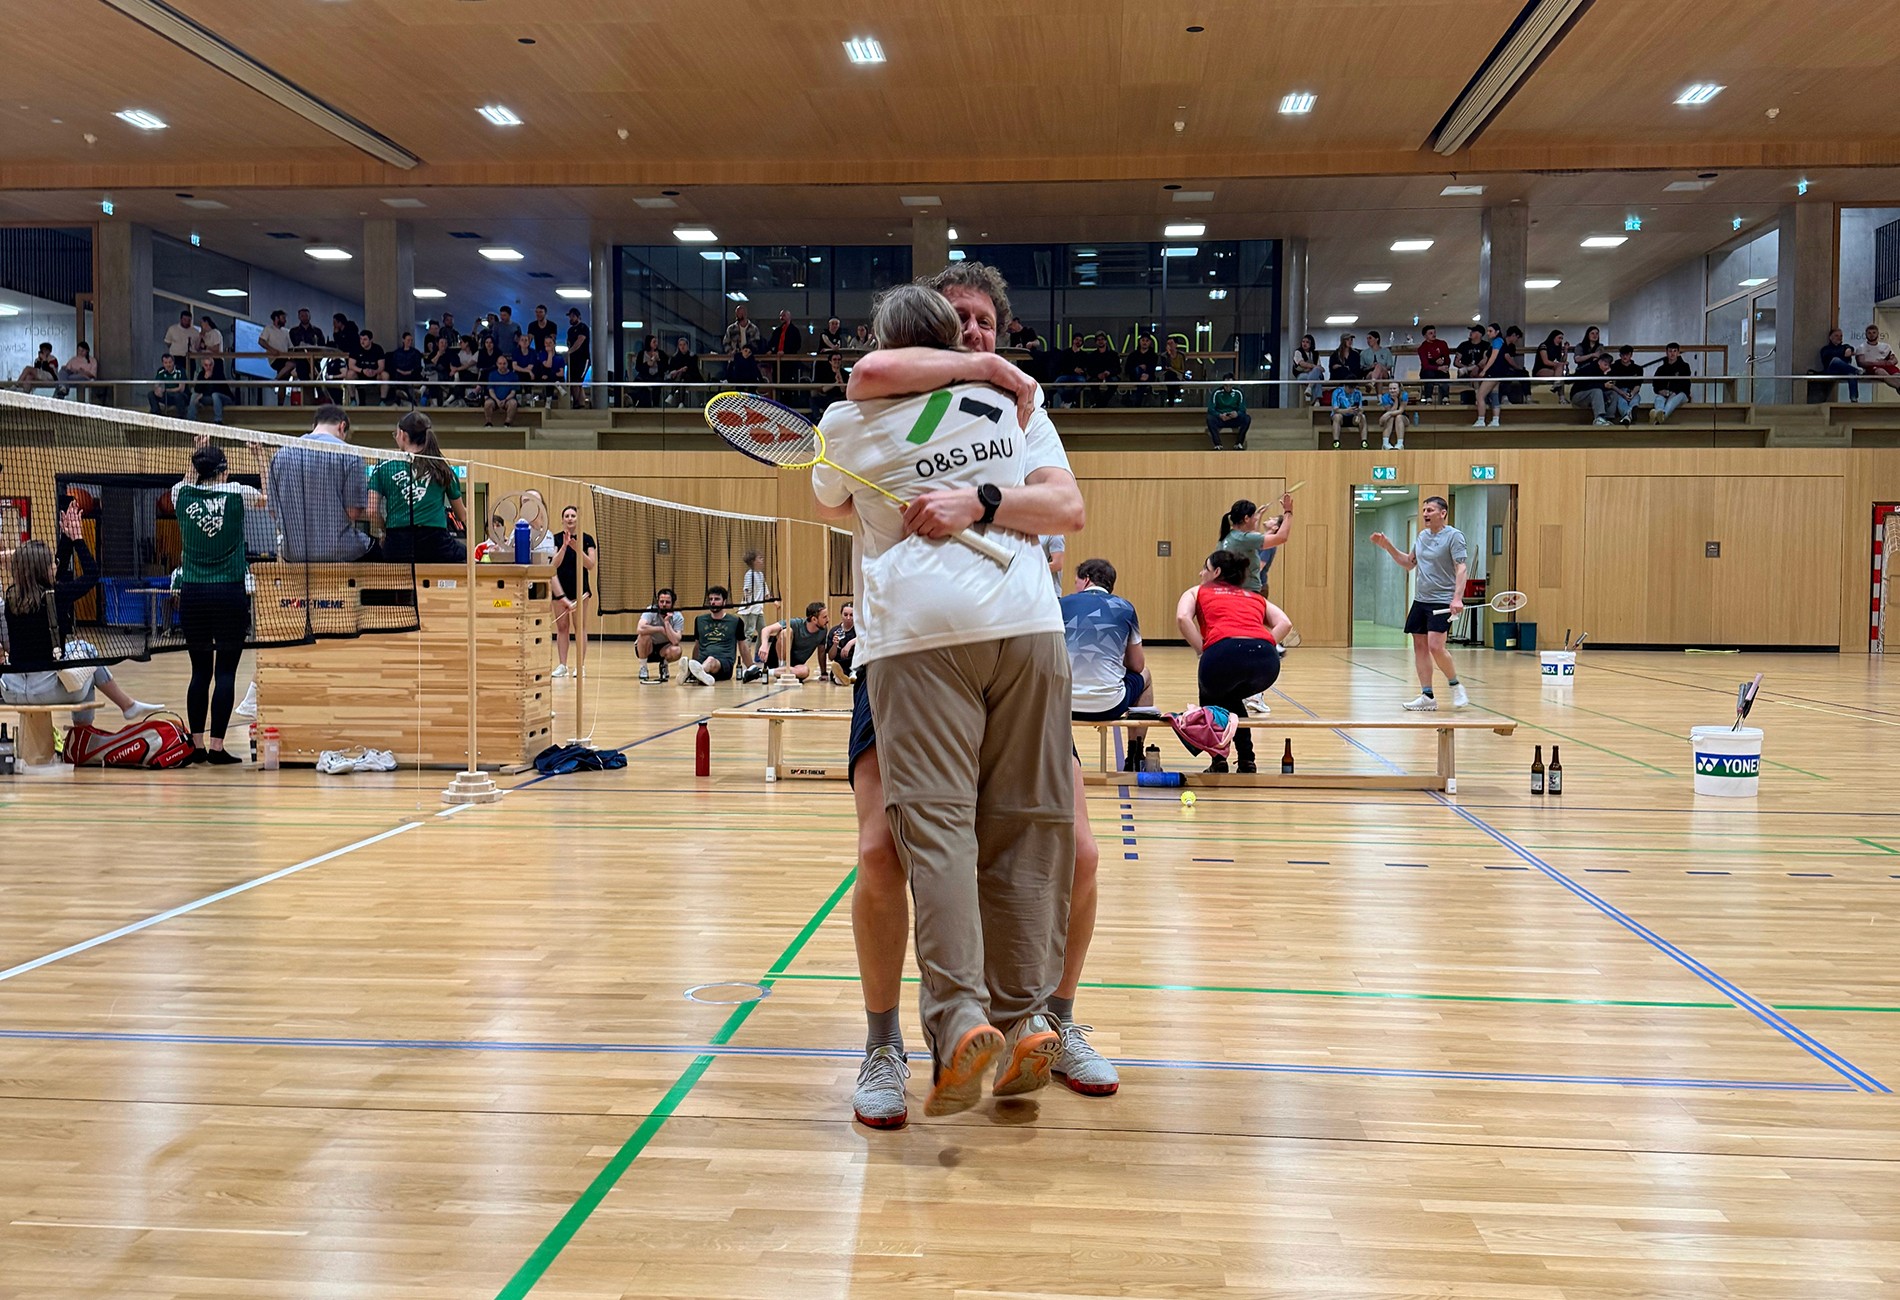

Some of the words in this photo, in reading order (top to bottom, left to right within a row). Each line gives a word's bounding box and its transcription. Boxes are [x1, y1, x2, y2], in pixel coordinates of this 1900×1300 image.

[915, 447, 968, 478] O&S
[971, 438, 1013, 461] BAU
[1542, 665, 1557, 674] NEX
